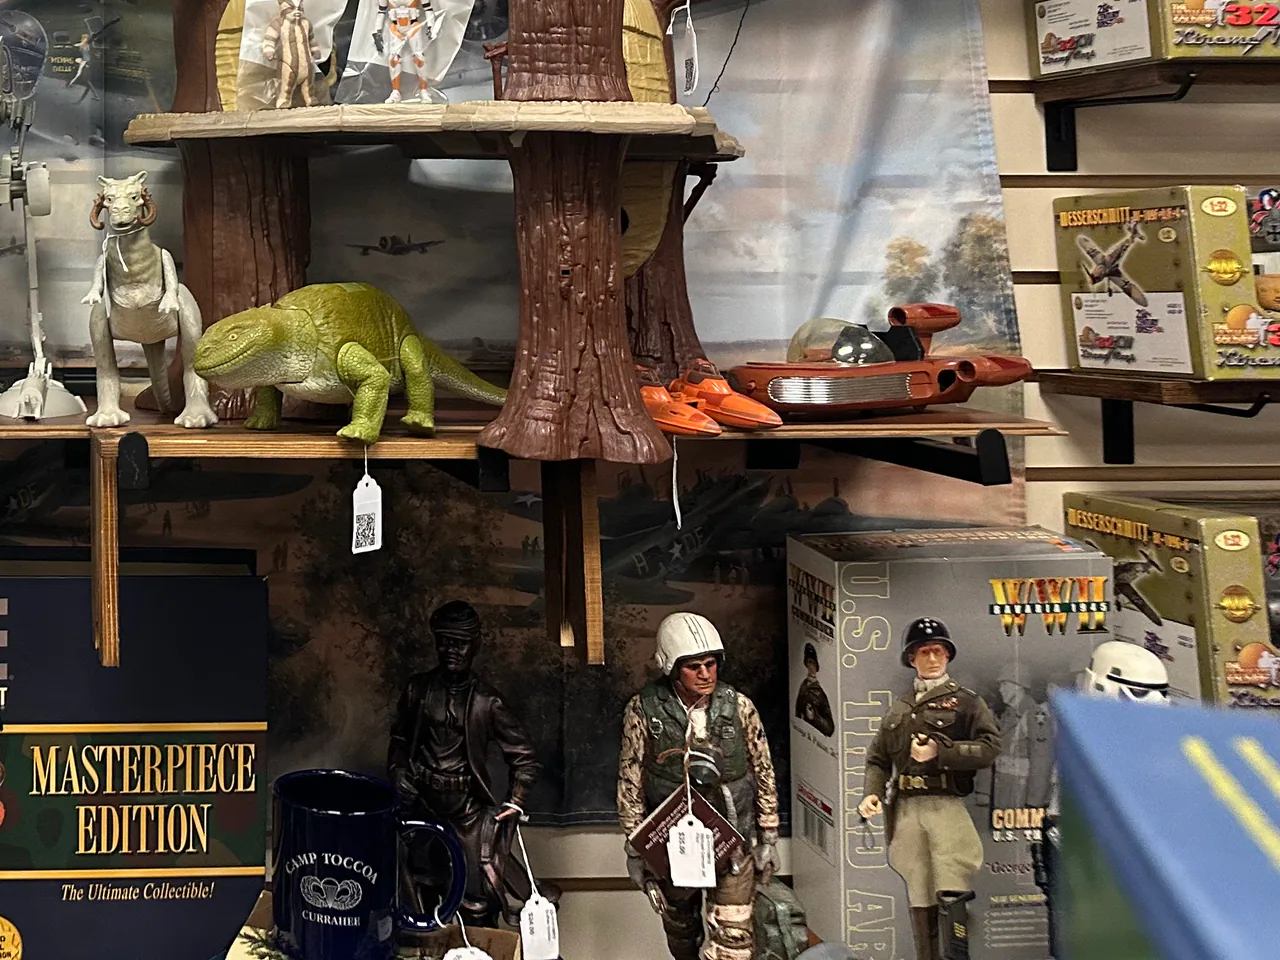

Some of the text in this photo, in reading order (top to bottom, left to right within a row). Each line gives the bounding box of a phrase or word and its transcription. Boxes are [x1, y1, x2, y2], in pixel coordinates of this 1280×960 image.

[1224, 4, 1280, 26] 32
[988, 576, 1111, 637] WWII
[993, 601, 1109, 615] BAVARIA 1945
[29, 743, 256, 796] MASTERPIECE
[74, 803, 212, 855] EDITION
[285, 852, 378, 885] CAMP TOCCOA
[61, 881, 215, 901] The Ultimate Collectible!
